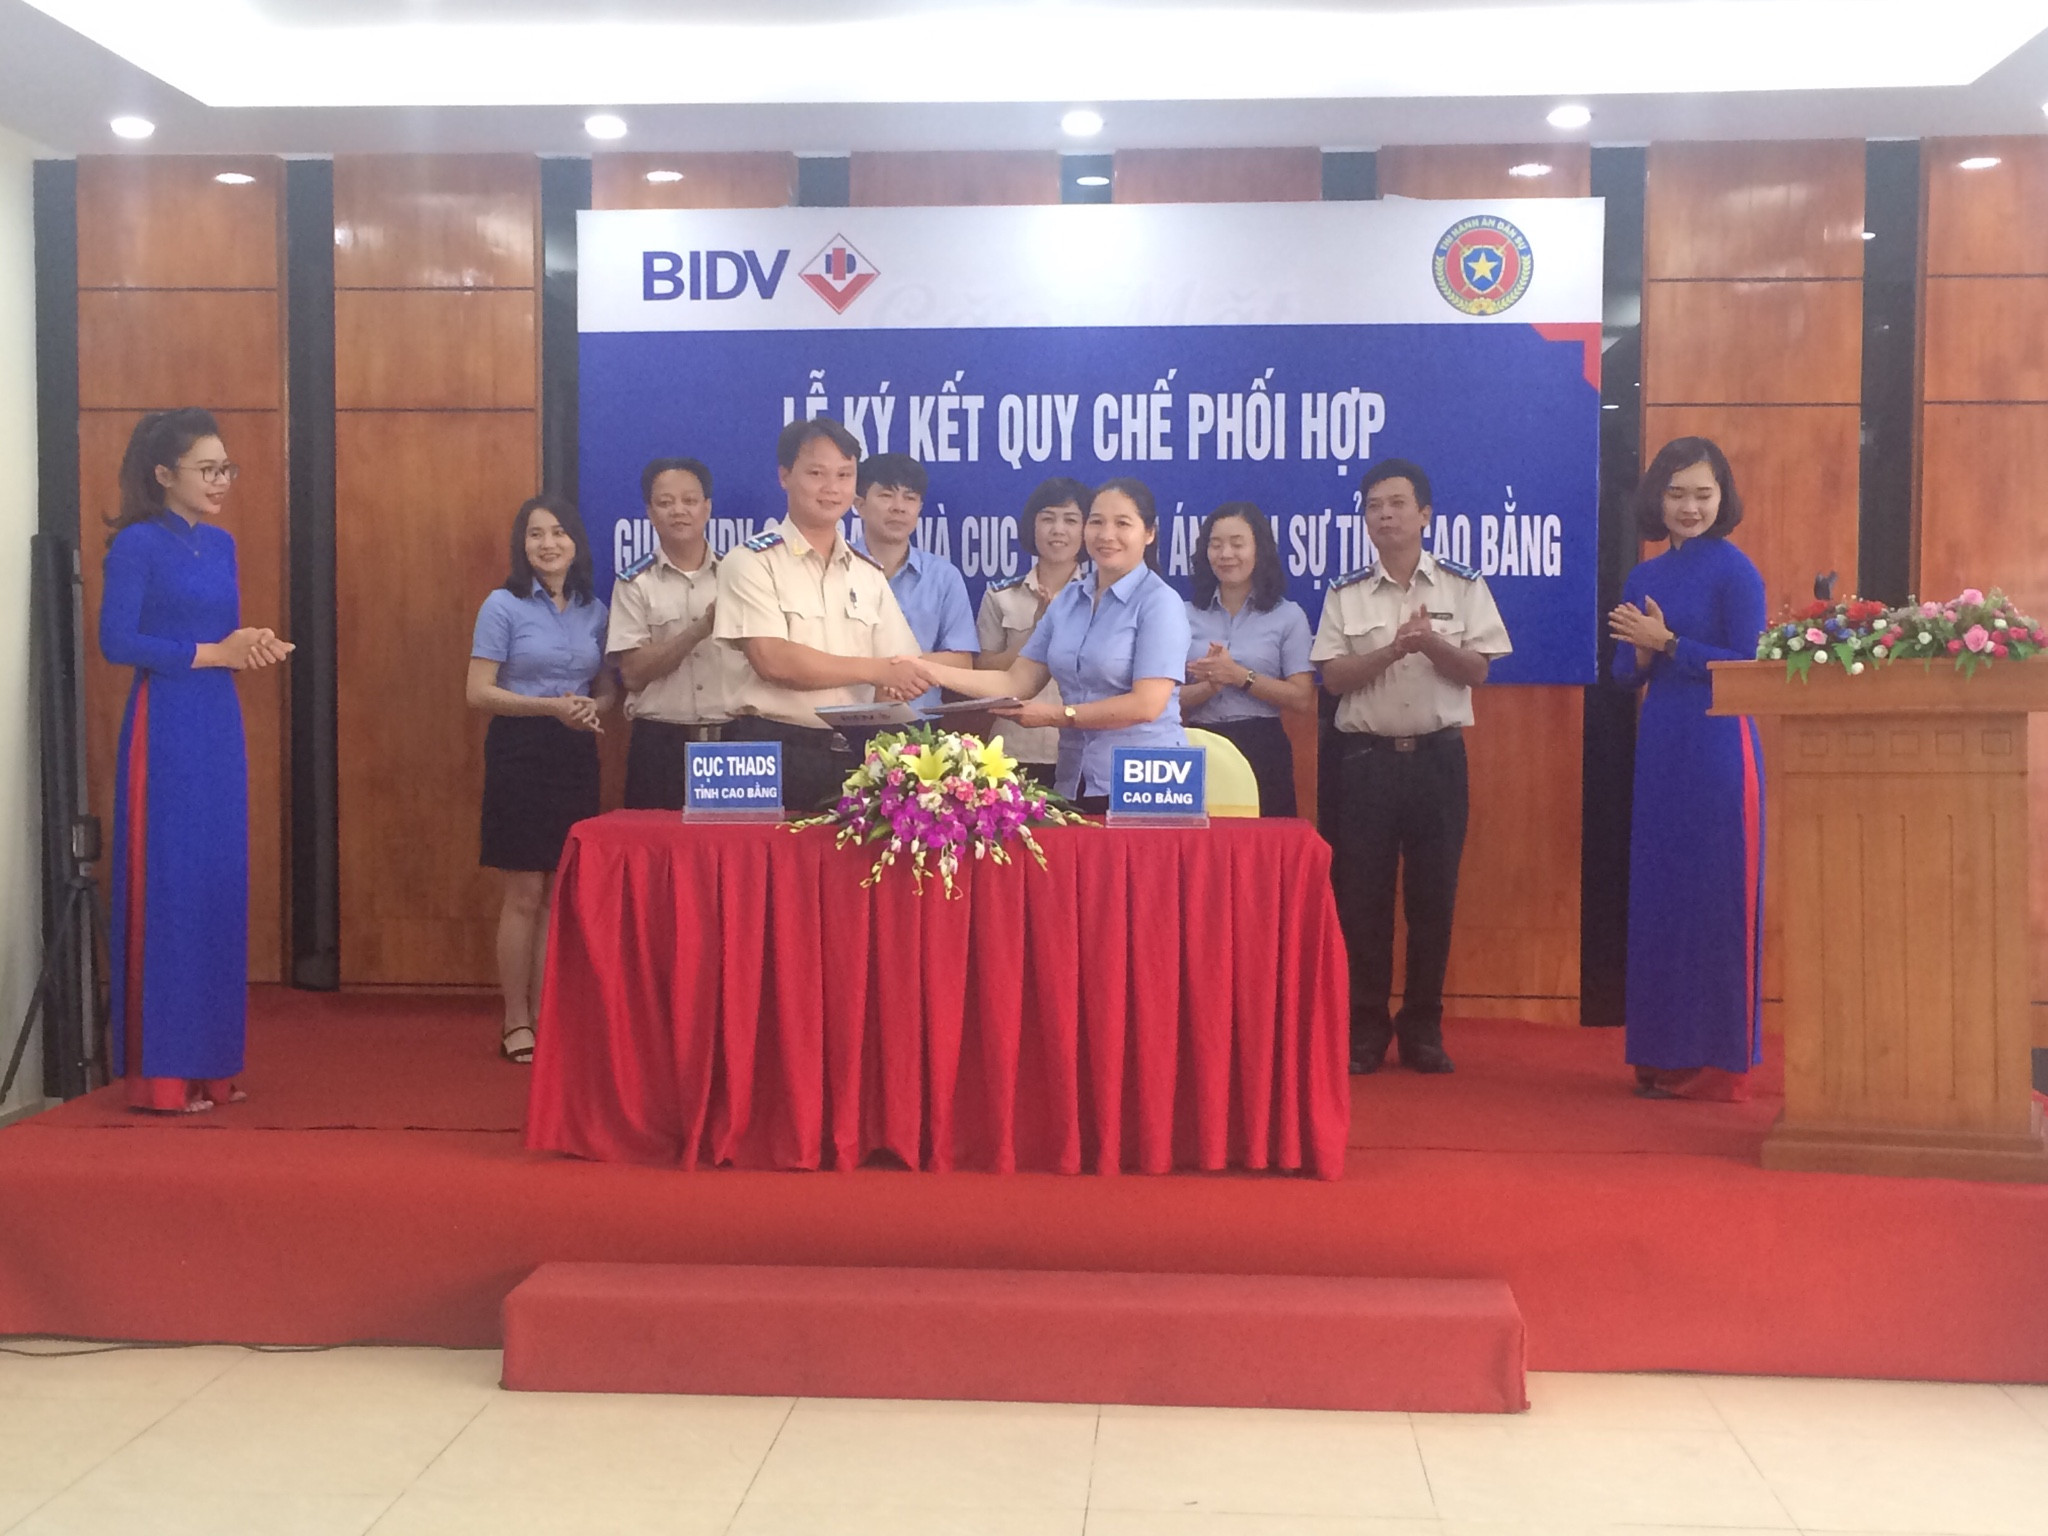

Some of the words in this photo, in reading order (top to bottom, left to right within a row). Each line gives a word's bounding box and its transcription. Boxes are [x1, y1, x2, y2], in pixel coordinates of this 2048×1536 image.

[643, 249, 791, 301] BIDV
[843, 381, 896, 463] KÝ
[909, 370, 985, 462] KẾT
[998, 394, 1079, 470] QUY
[1093, 368, 1177, 461] CHẾ
[1188, 367, 1286, 461] PHỐI
[1301, 386, 1386, 477] HỢP
[916, 503, 951, 562] VÀ
[1288, 509, 1331, 590] SỰ
[1480, 485, 1561, 577] BẰNG
[692, 756, 724, 783] CỤC
[726, 755, 776, 777] THADS
[1123, 759, 1193, 785] BIDV
[721, 787, 745, 799] CAO
[1122, 791, 1152, 804] CAO
